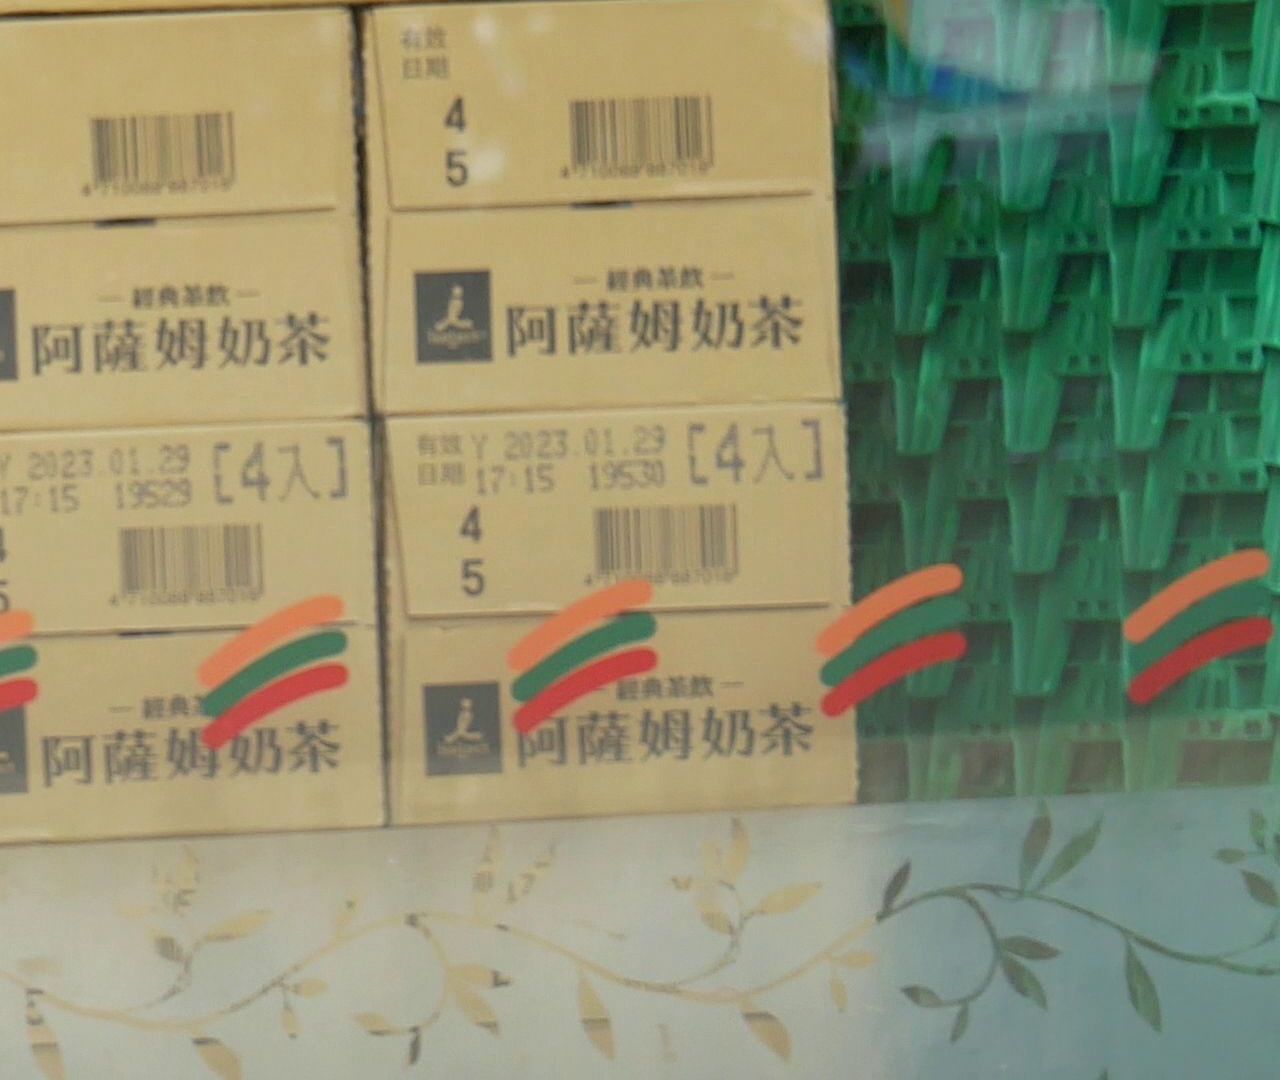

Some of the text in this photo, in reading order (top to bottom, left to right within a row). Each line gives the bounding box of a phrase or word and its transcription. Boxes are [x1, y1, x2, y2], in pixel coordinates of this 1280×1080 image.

[445, 97, 466, 132] 4
[445, 151, 468, 186] 5
[32, 312, 331, 375] 阿薩姆奶茶
[506, 295, 803, 357] 阿薩姆奶茶
[460, 507, 482, 541] 4
[461, 560, 485, 595] 5
[42, 720, 340, 787] 阿薩姆奶茶
[517, 703, 814, 767] 阿薩姆奶茶
